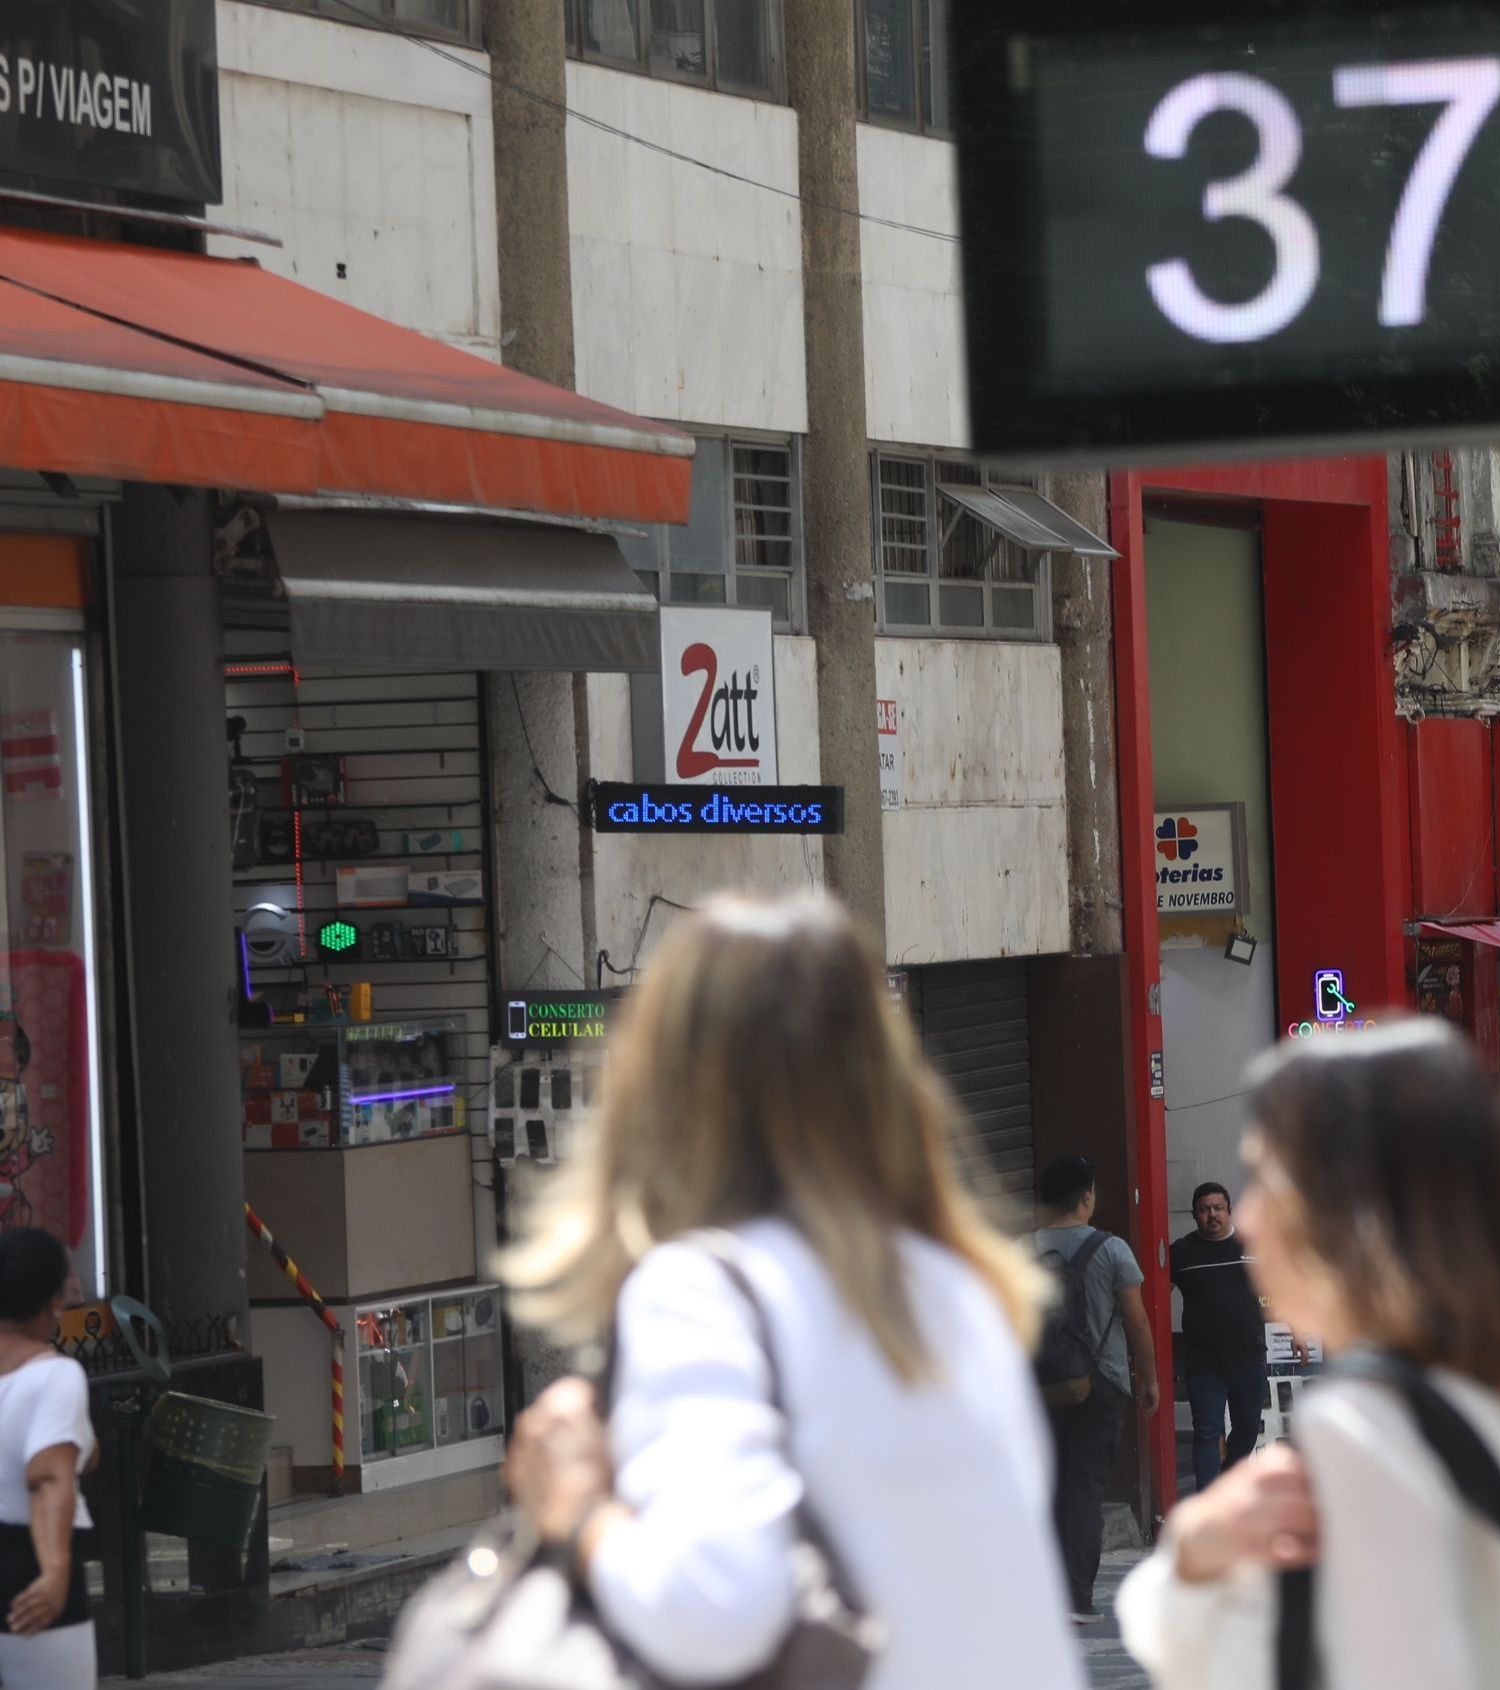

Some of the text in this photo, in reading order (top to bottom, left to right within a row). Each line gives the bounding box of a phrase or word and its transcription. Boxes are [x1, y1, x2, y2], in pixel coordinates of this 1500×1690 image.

[18, 58, 44, 119] P/
[49, 64, 151, 137] VIAGEM
[712, 772, 762, 785] COLLECTION
[608, 793, 822, 824] cabos diversos
[1169, 892, 1234, 907] NOVEMBRO
[528, 1003, 605, 1019] CONSERTO
[528, 1022, 604, 1037] CELULAR
